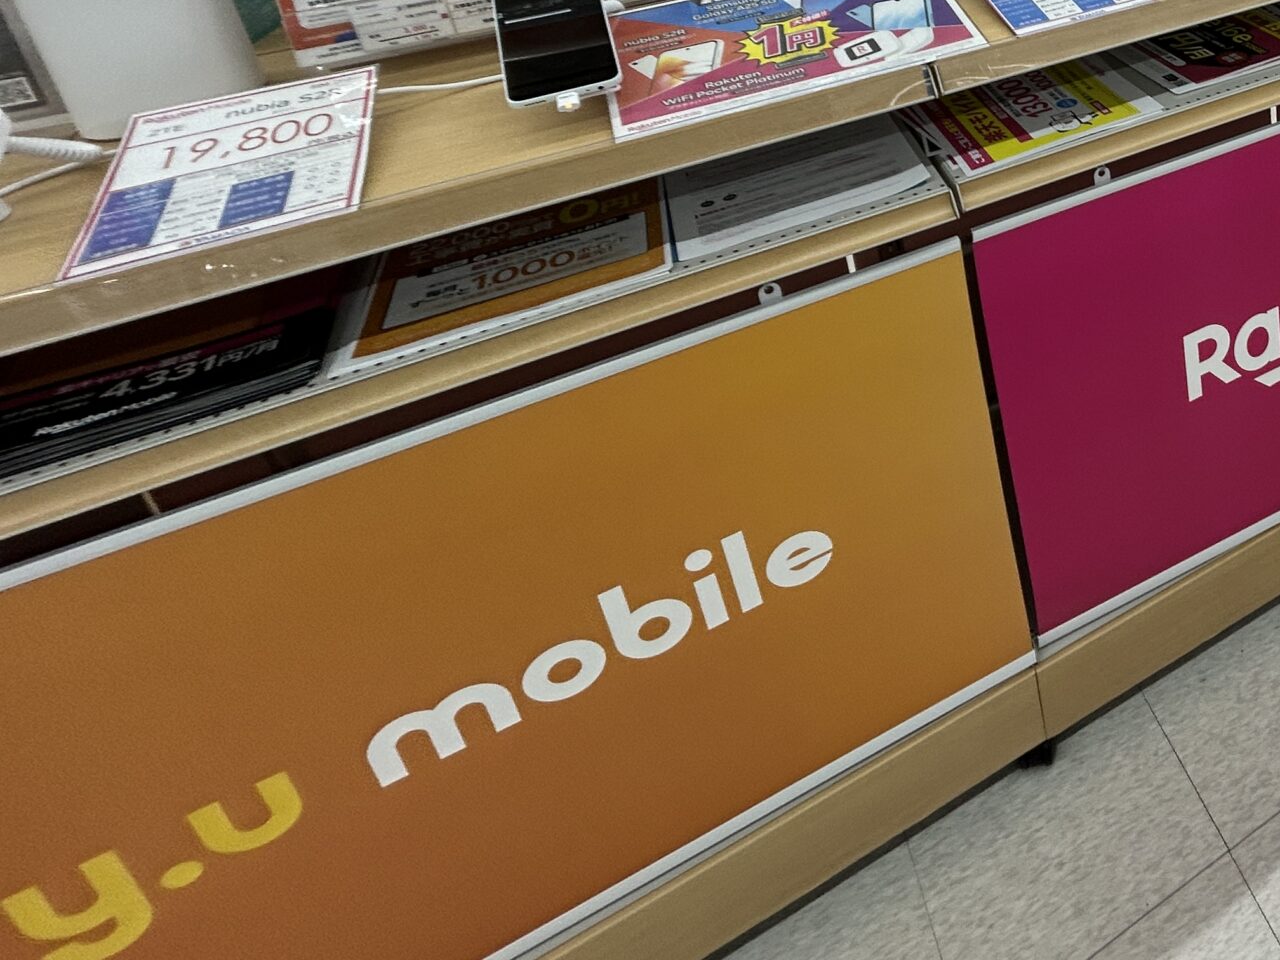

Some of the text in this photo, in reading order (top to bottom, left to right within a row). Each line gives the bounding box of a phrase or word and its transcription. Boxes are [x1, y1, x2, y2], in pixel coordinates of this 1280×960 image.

[623, 33, 661, 47] nubia
[748, 23, 827, 59] 1円
[662, 67, 806, 107] WiFi Pocket Platinum
[705, 70, 762, 89] Rakuten
[224, 98, 292, 119] nubia
[148, 123, 186, 138] ZTE
[161, 112, 333, 171] 19,800
[2, 530, 833, 960] y.u mobile
